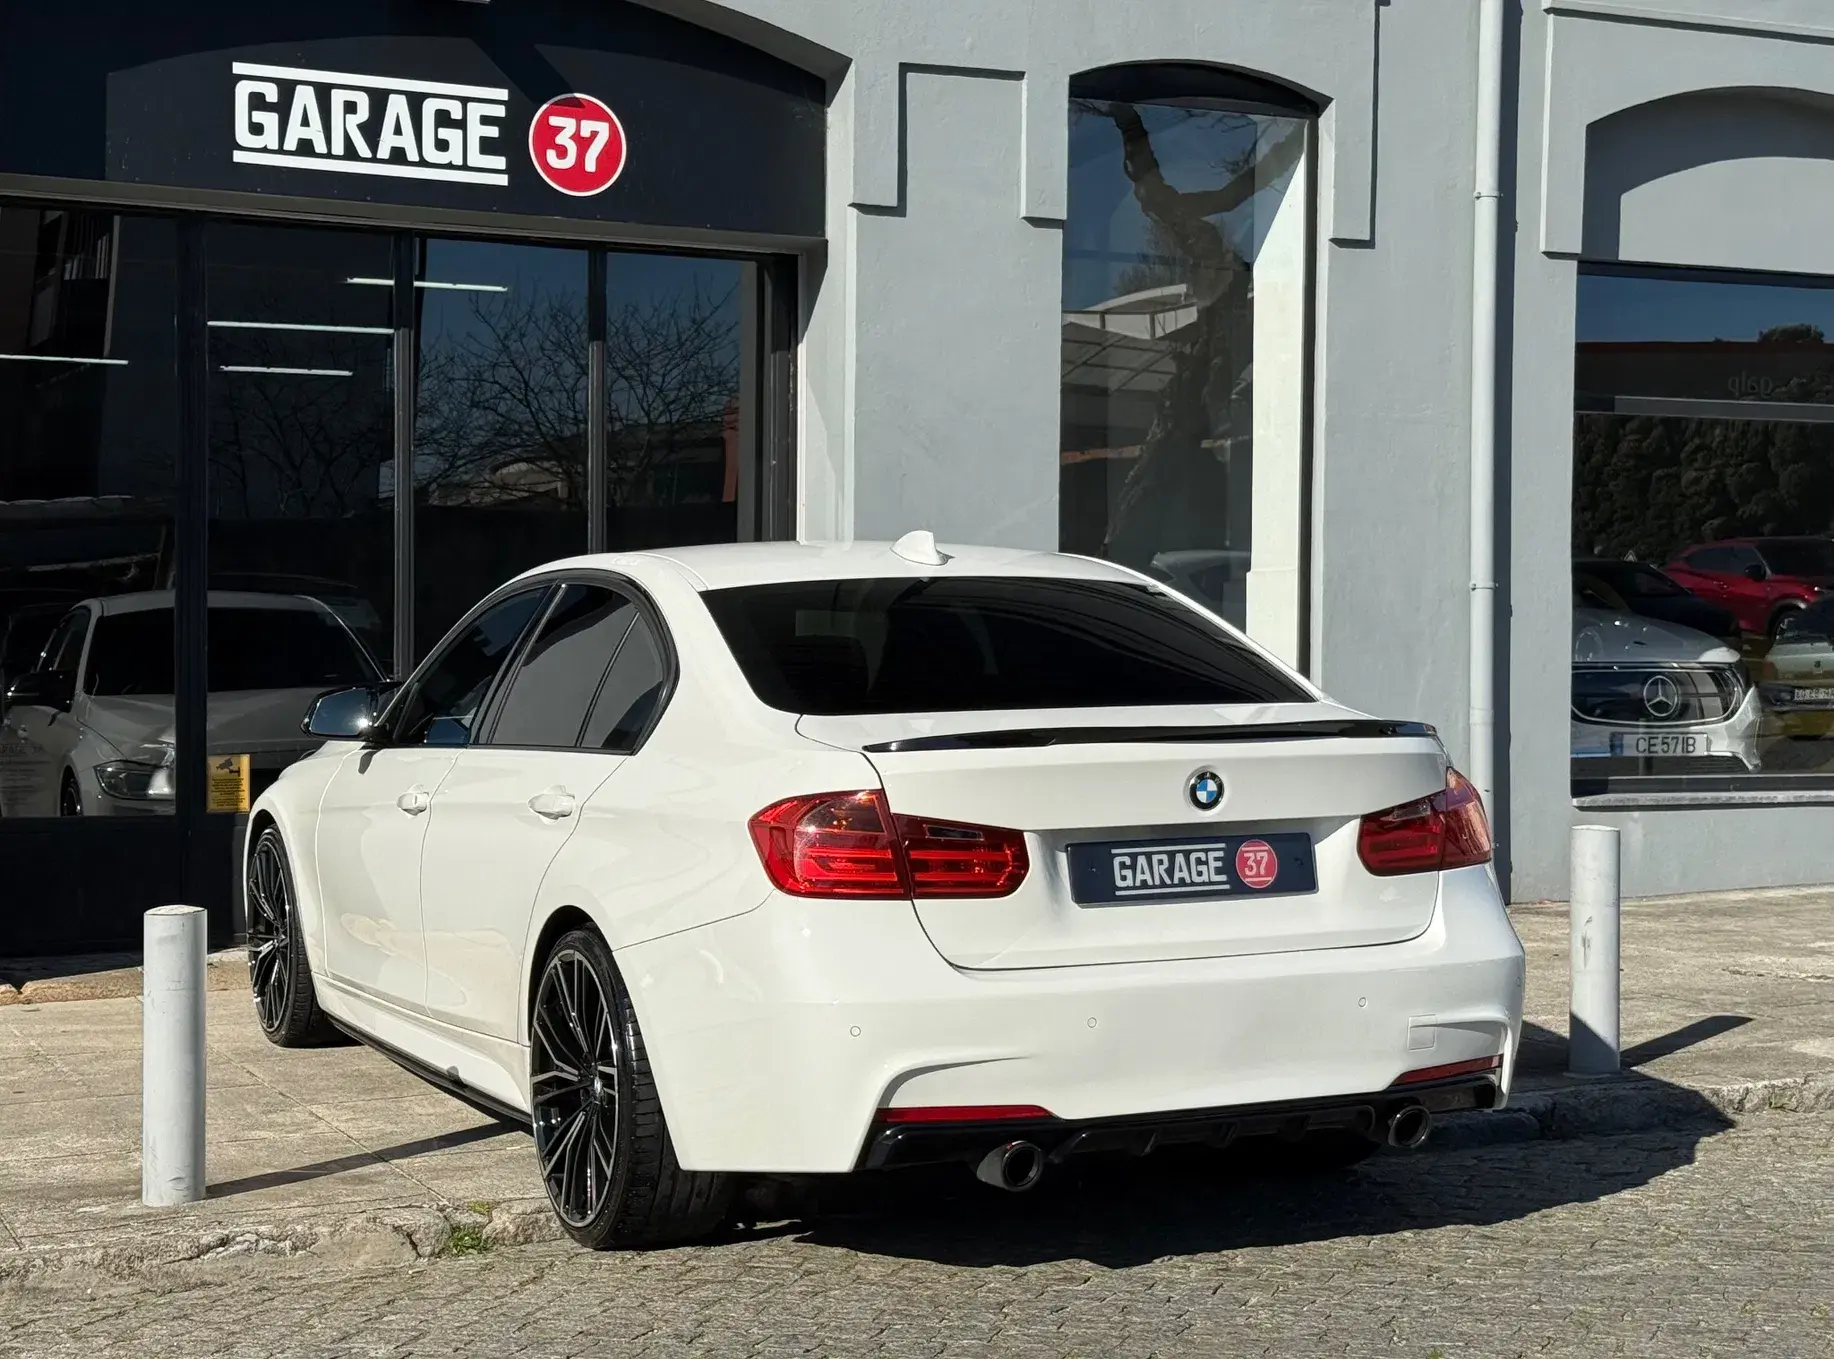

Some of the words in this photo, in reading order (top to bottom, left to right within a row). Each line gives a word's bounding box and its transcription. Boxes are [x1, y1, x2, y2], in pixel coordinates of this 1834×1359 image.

[235, 80, 507, 170] GARAGE
[546, 115, 610, 173] 37
[1114, 851, 1227, 888] GARAGE
[1243, 852, 1269, 876] 37
